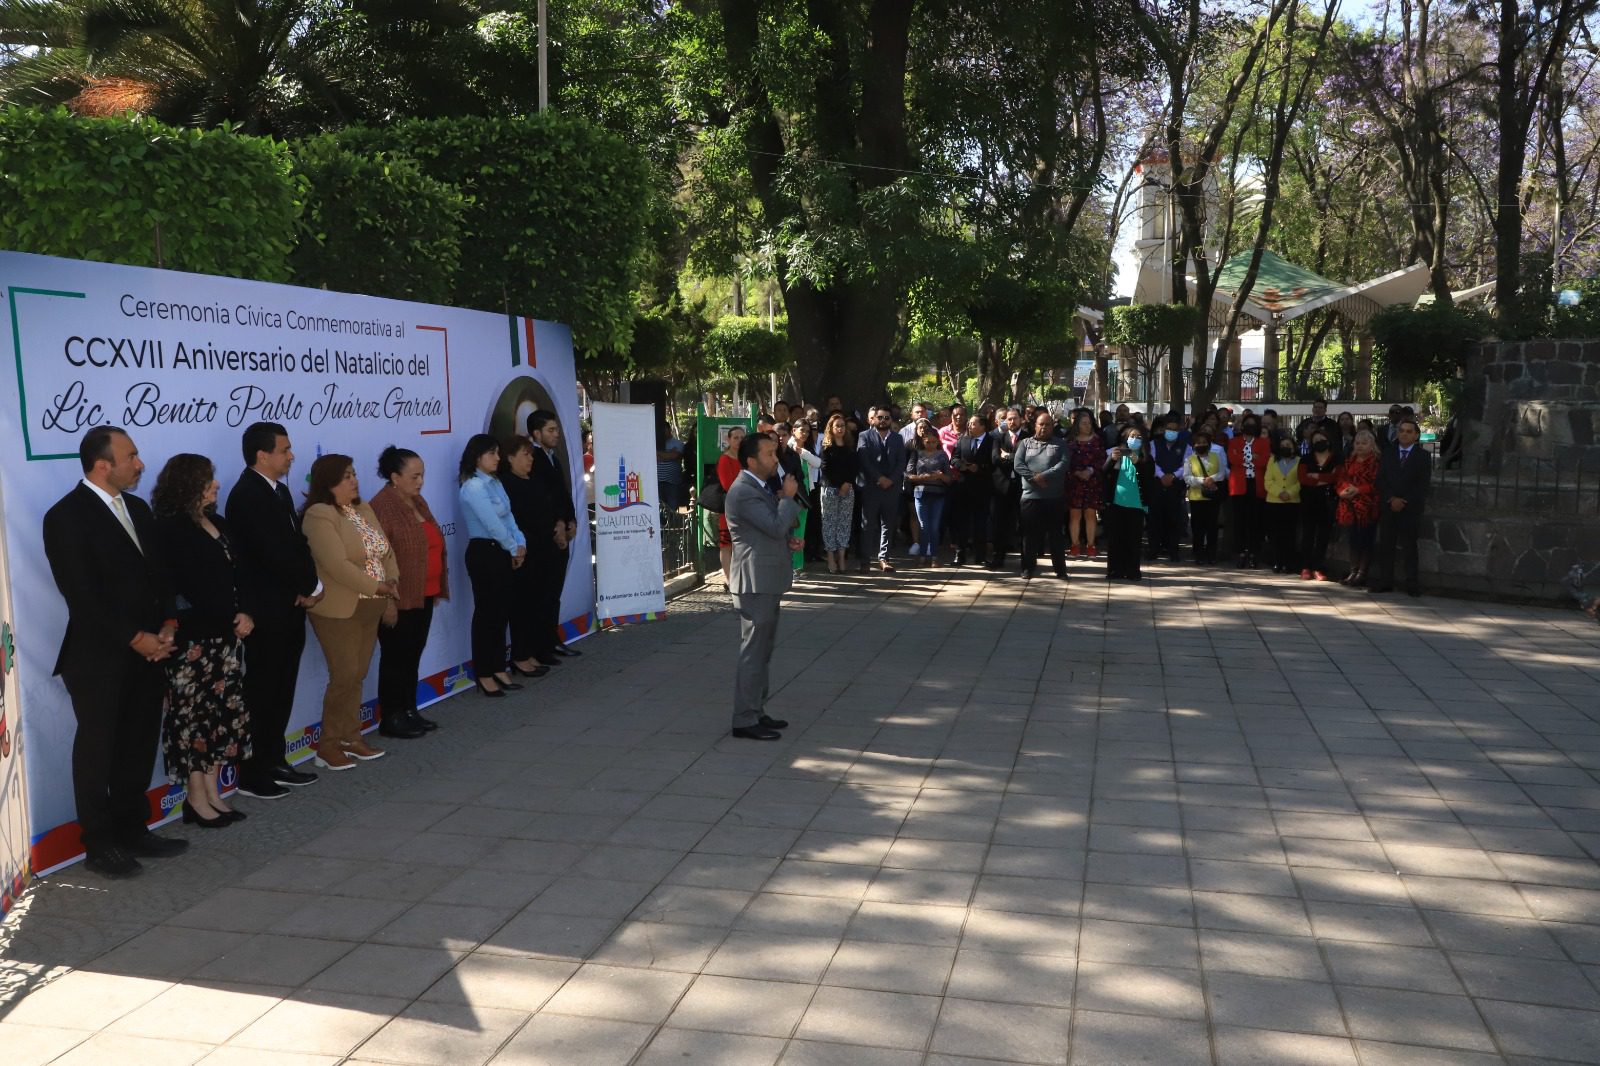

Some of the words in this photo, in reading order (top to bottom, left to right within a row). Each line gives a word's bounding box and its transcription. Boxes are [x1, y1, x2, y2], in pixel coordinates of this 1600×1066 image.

[120, 294, 230, 324] Ceremonia
[235, 304, 282, 328] Cívica
[286, 310, 392, 337] Conmemorativa
[395, 320, 405, 338] al
[64, 336, 164, 369] CCXVII
[173, 341, 296, 373] Aniversario
[301, 347, 329, 374] del
[335, 350, 404, 376] Natalicio
[408, 353, 430, 376] del
[42, 380, 111, 433] Lic.
[122, 382, 219, 427] Benito
[226, 384, 303, 427] Pablo
[309, 382, 380, 426] Juárez
[383, 386, 443, 424] García
[441, 522, 457, 537] 023
[286, 734, 312, 754] iento
